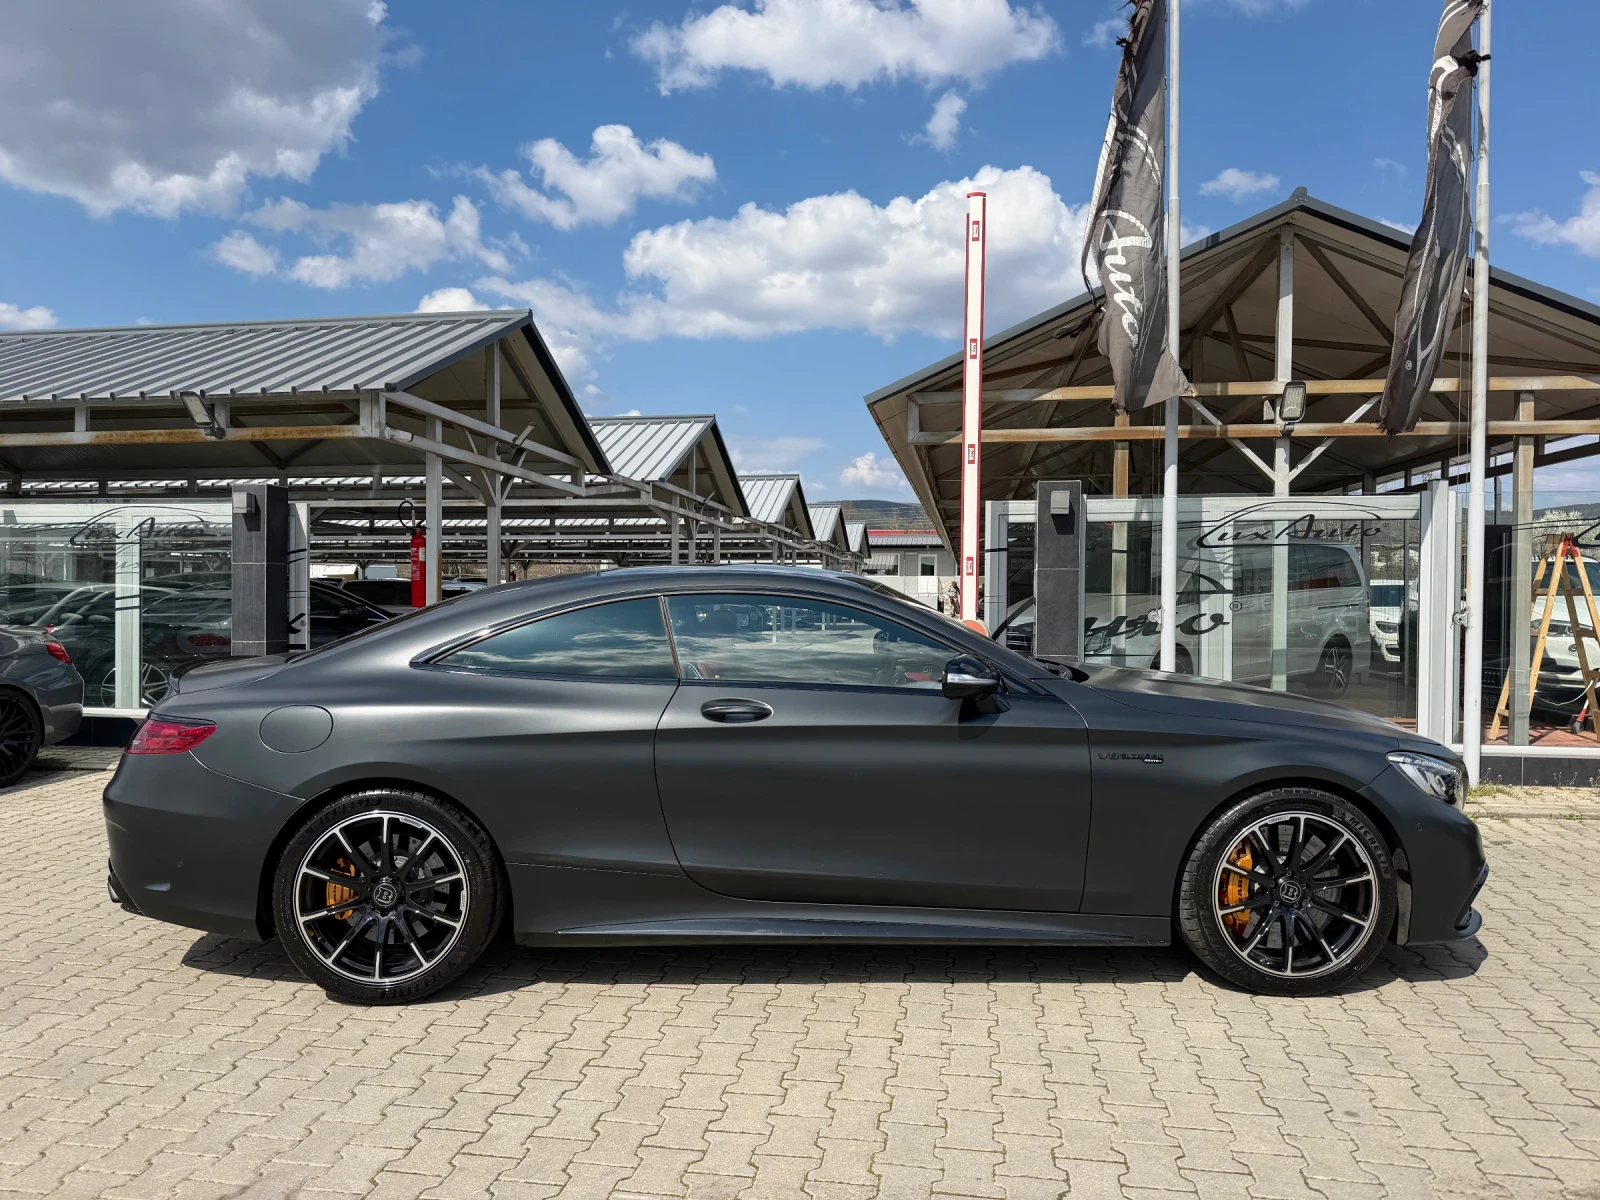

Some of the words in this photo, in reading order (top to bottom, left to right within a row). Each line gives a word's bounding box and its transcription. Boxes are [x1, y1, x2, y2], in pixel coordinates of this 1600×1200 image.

[1099, 209, 1153, 347] Auto
[1196, 512, 1273, 549] Lux
[1274, 513, 1384, 541] Auto
[1349, 815, 1390, 876] MICHELIN
